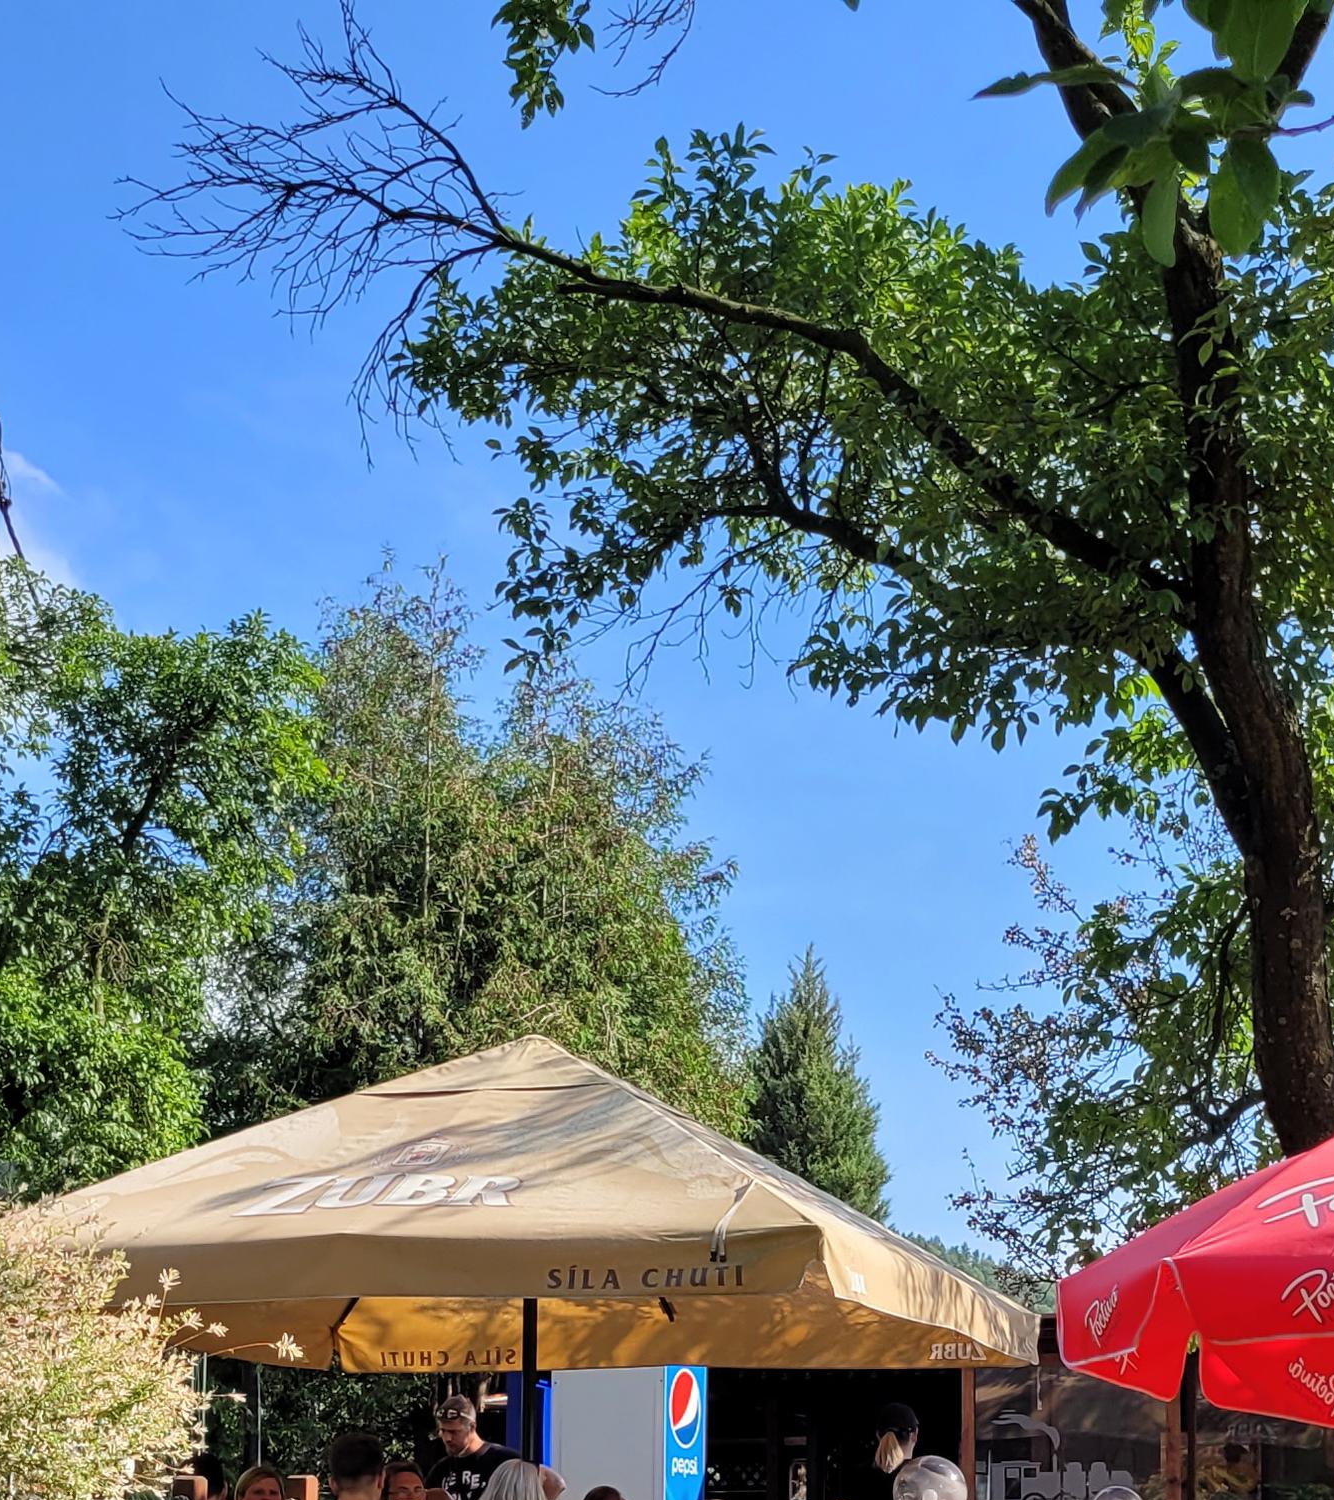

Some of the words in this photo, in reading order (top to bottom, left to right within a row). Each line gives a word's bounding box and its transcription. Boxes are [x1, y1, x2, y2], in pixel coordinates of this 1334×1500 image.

[231, 1171, 524, 1218] ZUBR
[547, 1264, 621, 1290] SÍLA
[641, 1264, 744, 1289] CHUTI
[1084, 1284, 1118, 1348] Poctivá
[671, 1456, 699, 1477] pepsi
